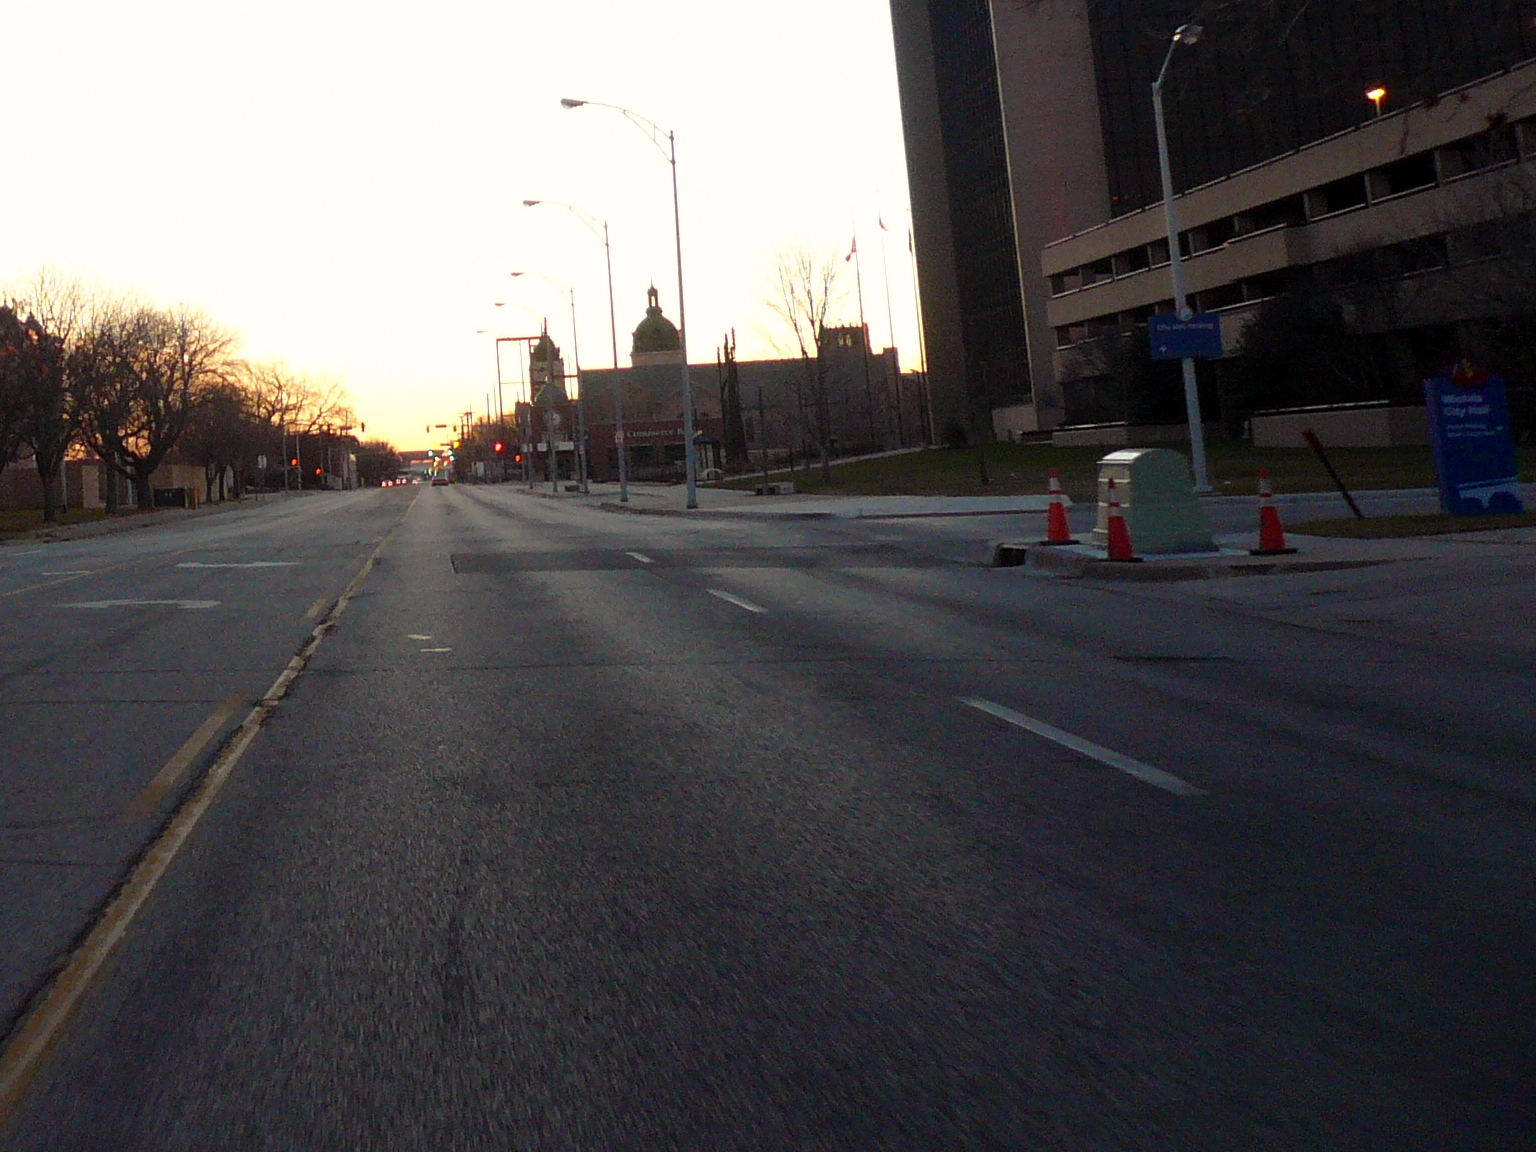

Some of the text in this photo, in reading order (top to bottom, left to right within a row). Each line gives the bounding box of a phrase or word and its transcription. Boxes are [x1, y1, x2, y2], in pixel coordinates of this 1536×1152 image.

[1443, 404, 1490, 418] City Hall
[627, 428, 674, 438] Commerce
